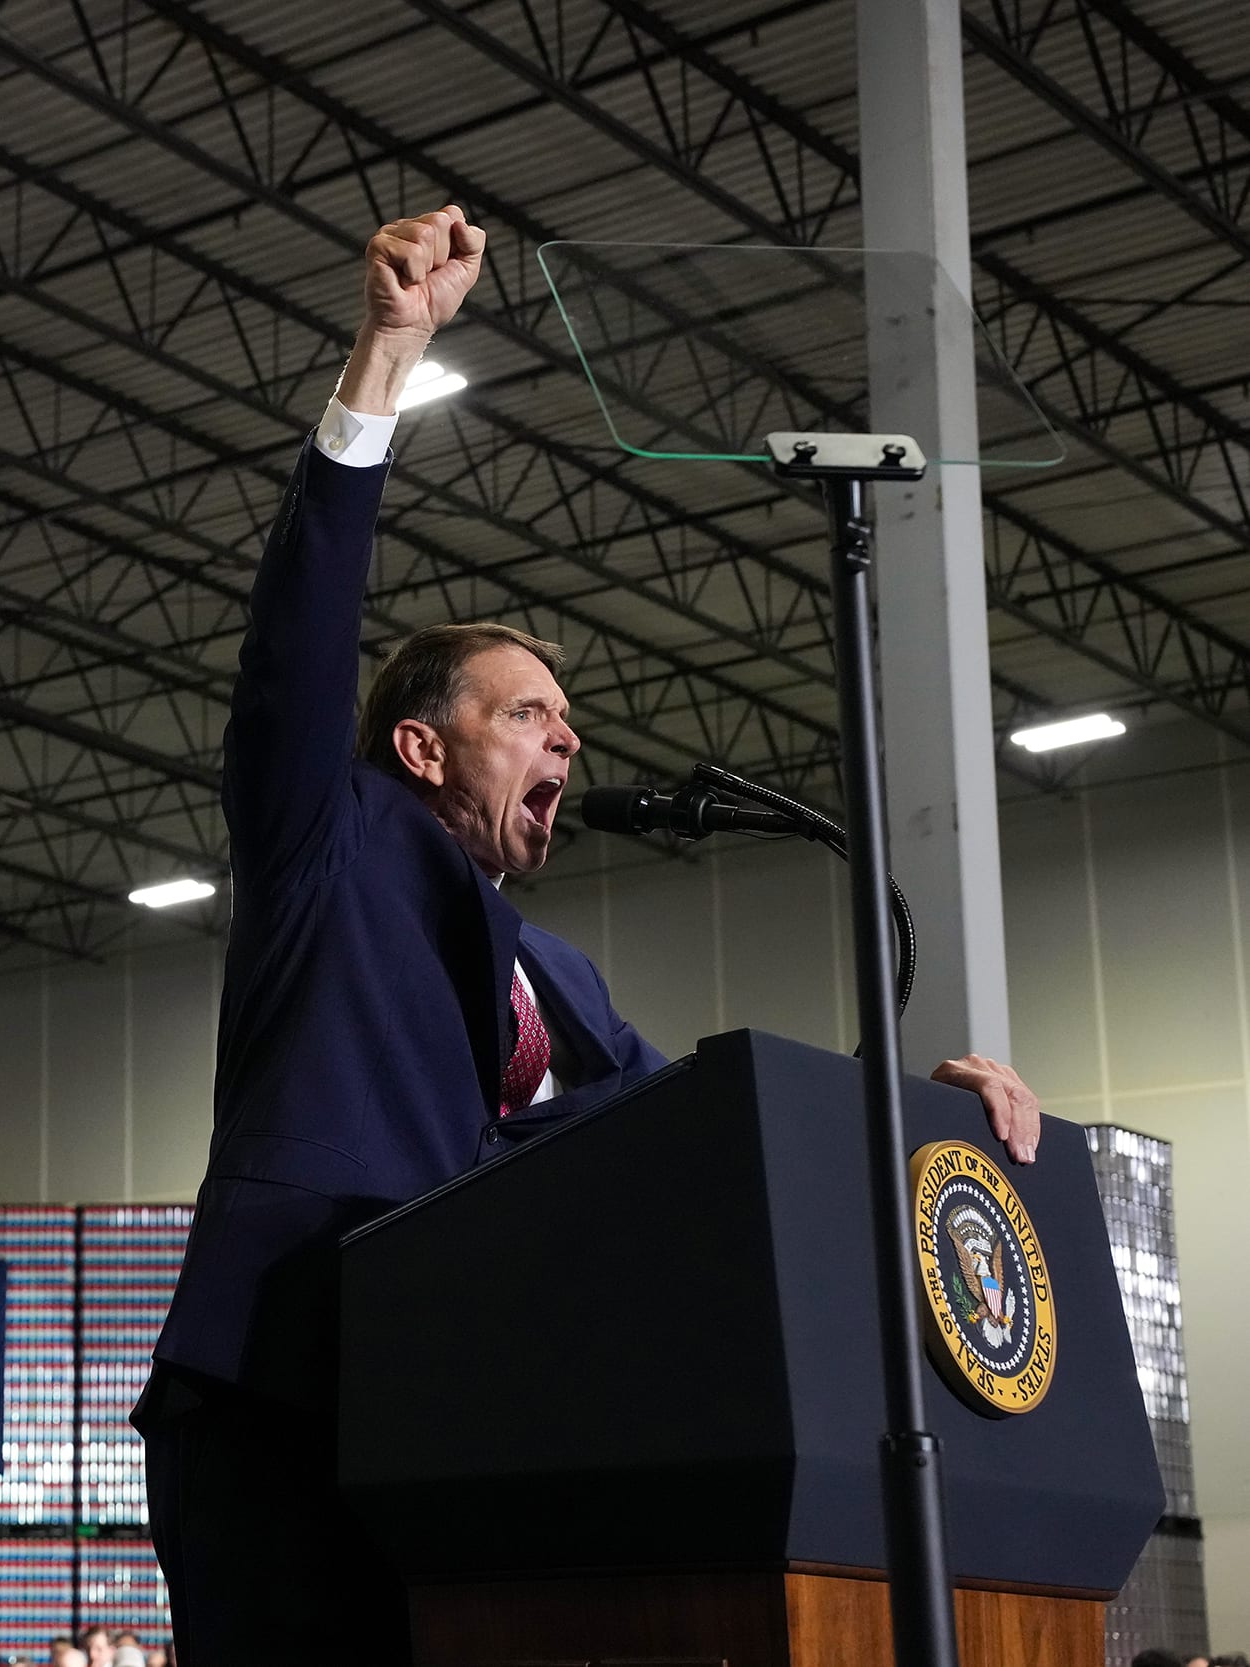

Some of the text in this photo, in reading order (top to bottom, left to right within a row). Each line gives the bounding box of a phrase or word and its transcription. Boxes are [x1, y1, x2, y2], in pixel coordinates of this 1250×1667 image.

[920, 1150, 1051, 1402] SEAL OF THE PRESIDENT OF THE UNITED STATES
